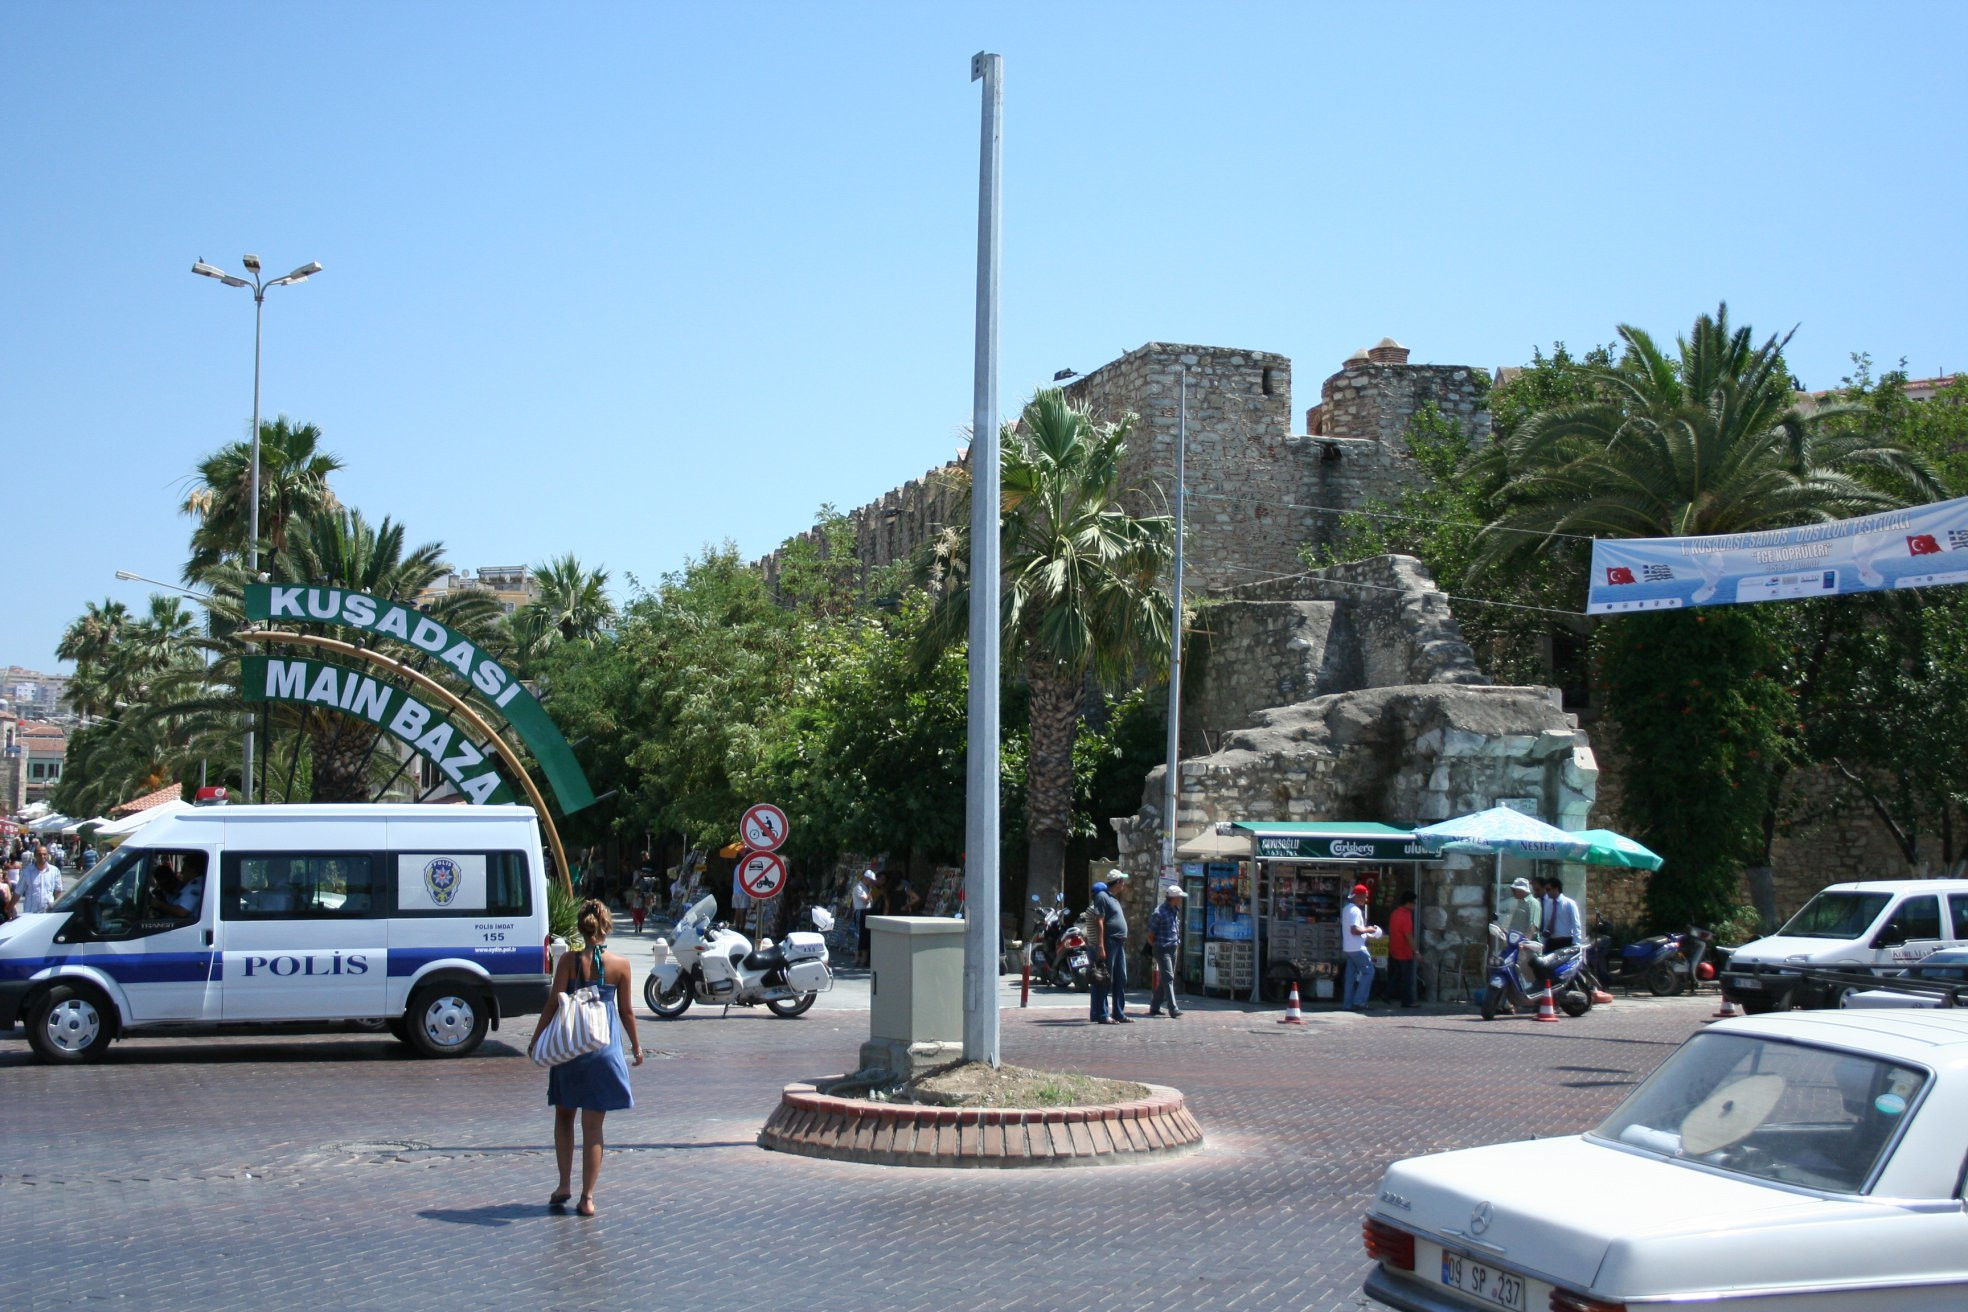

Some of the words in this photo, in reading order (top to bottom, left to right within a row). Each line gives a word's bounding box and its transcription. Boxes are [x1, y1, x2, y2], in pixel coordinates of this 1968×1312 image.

[1796, 522, 1848, 542] DOSTLUK
[270, 587, 521, 708] KUŞADASI
[265, 659, 393, 722] MAIN
[388, 697, 516, 805] BAZA
[1330, 840, 1374, 857] Carlsberg
[1520, 841, 1556, 851] NESTEA
[483, 932, 505, 942] 155
[241, 950, 369, 977] POLİS
[1448, 1256, 1463, 1285] 09
[1471, 1265, 1486, 1293] SP
[1497, 1273, 1521, 1306] 237
